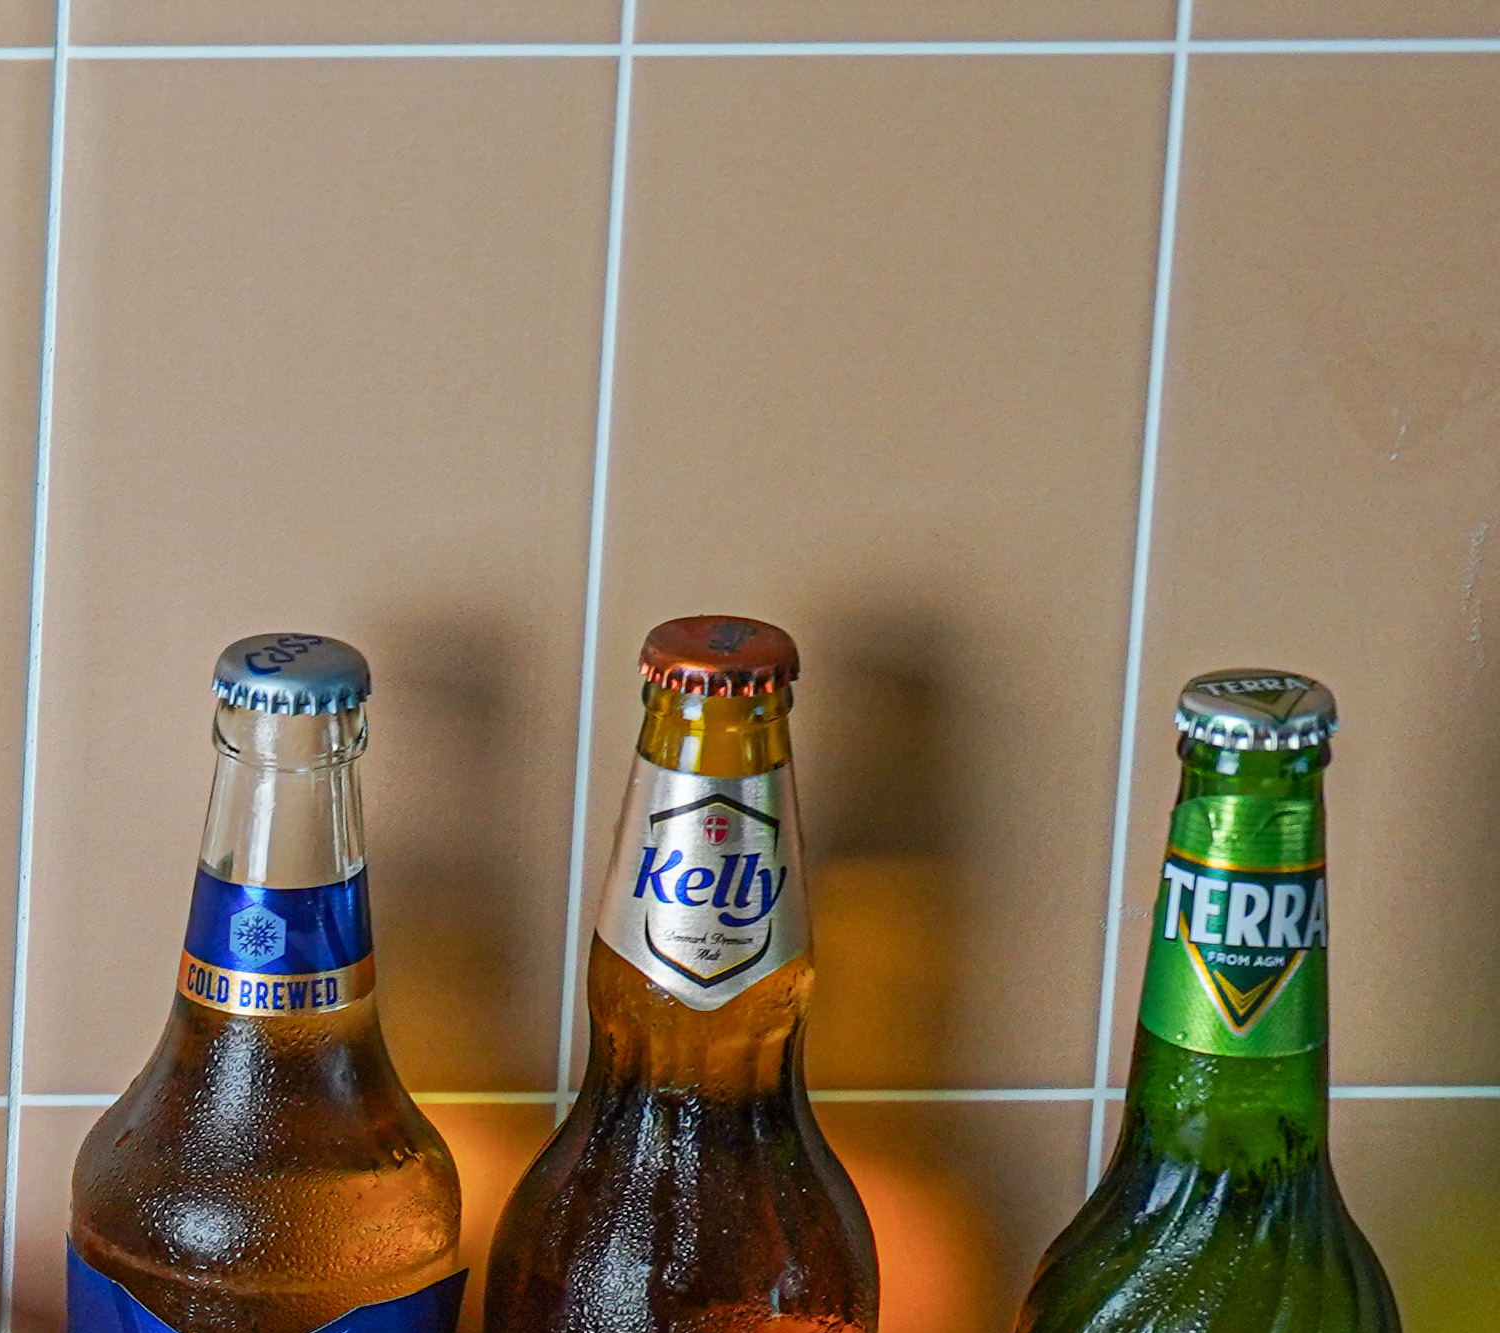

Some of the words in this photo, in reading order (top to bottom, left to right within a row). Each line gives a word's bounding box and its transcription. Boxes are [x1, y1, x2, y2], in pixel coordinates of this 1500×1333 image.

[1197, 677, 1309, 696] TERRA
[633, 847, 787, 927] Kelly
[1163, 862, 1326, 949] TERRA
[1206, 951, 1250, 967] FROM
[187, 963, 230, 1003] COLD
[239, 977, 338, 1010] BREWED
